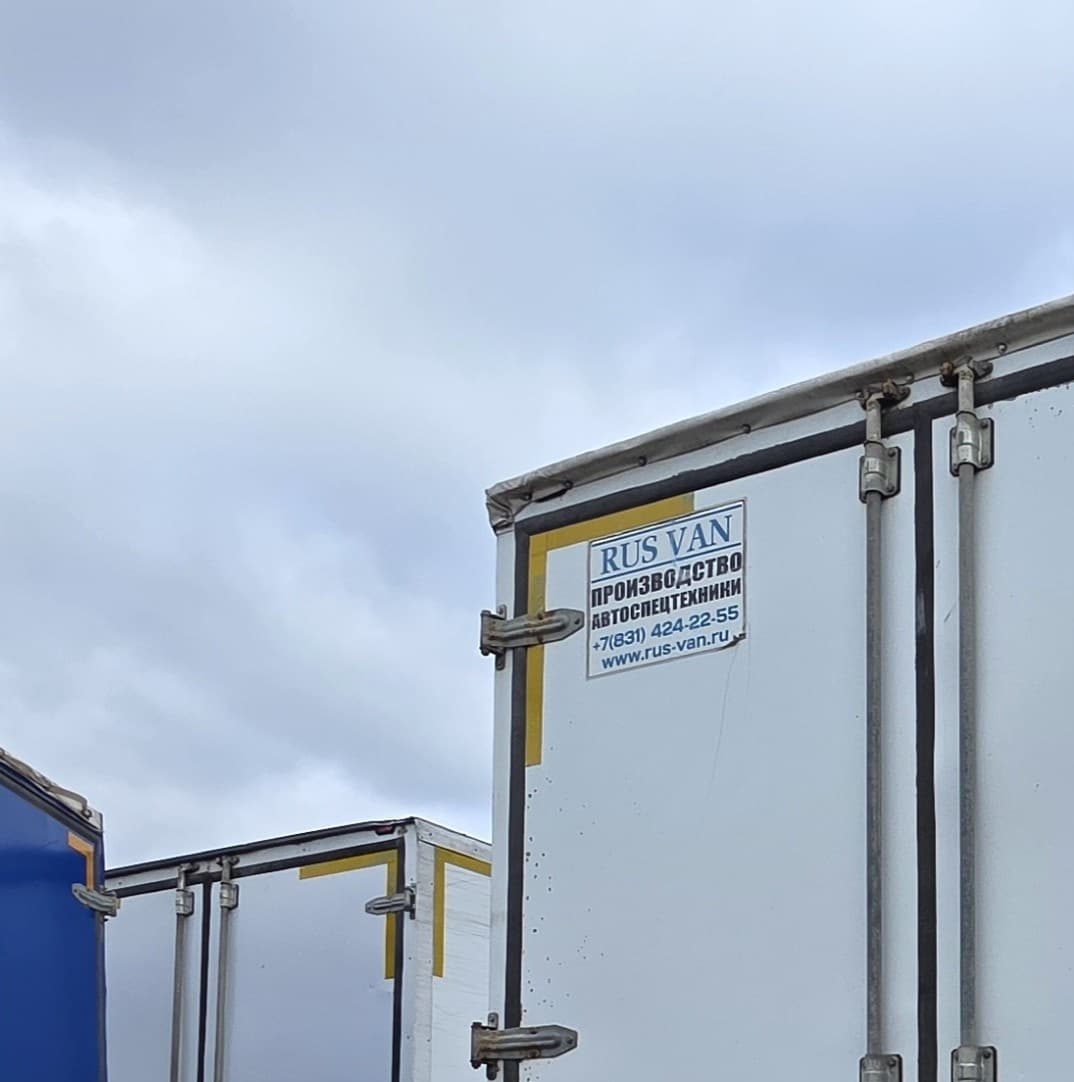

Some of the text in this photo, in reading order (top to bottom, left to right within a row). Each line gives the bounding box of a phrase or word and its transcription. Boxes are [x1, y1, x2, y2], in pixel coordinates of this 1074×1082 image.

[600, 514, 733, 574] RUS VAN
[591, 551, 742, 608] ПРОИЗВОДСТВО
[591, 577, 741, 631] АВТОСПЕЦТЕХНИКИ
[592, 604, 739, 652] +7(831) 424-22-55
[602, 629, 730, 669] www.rus-van.ru
